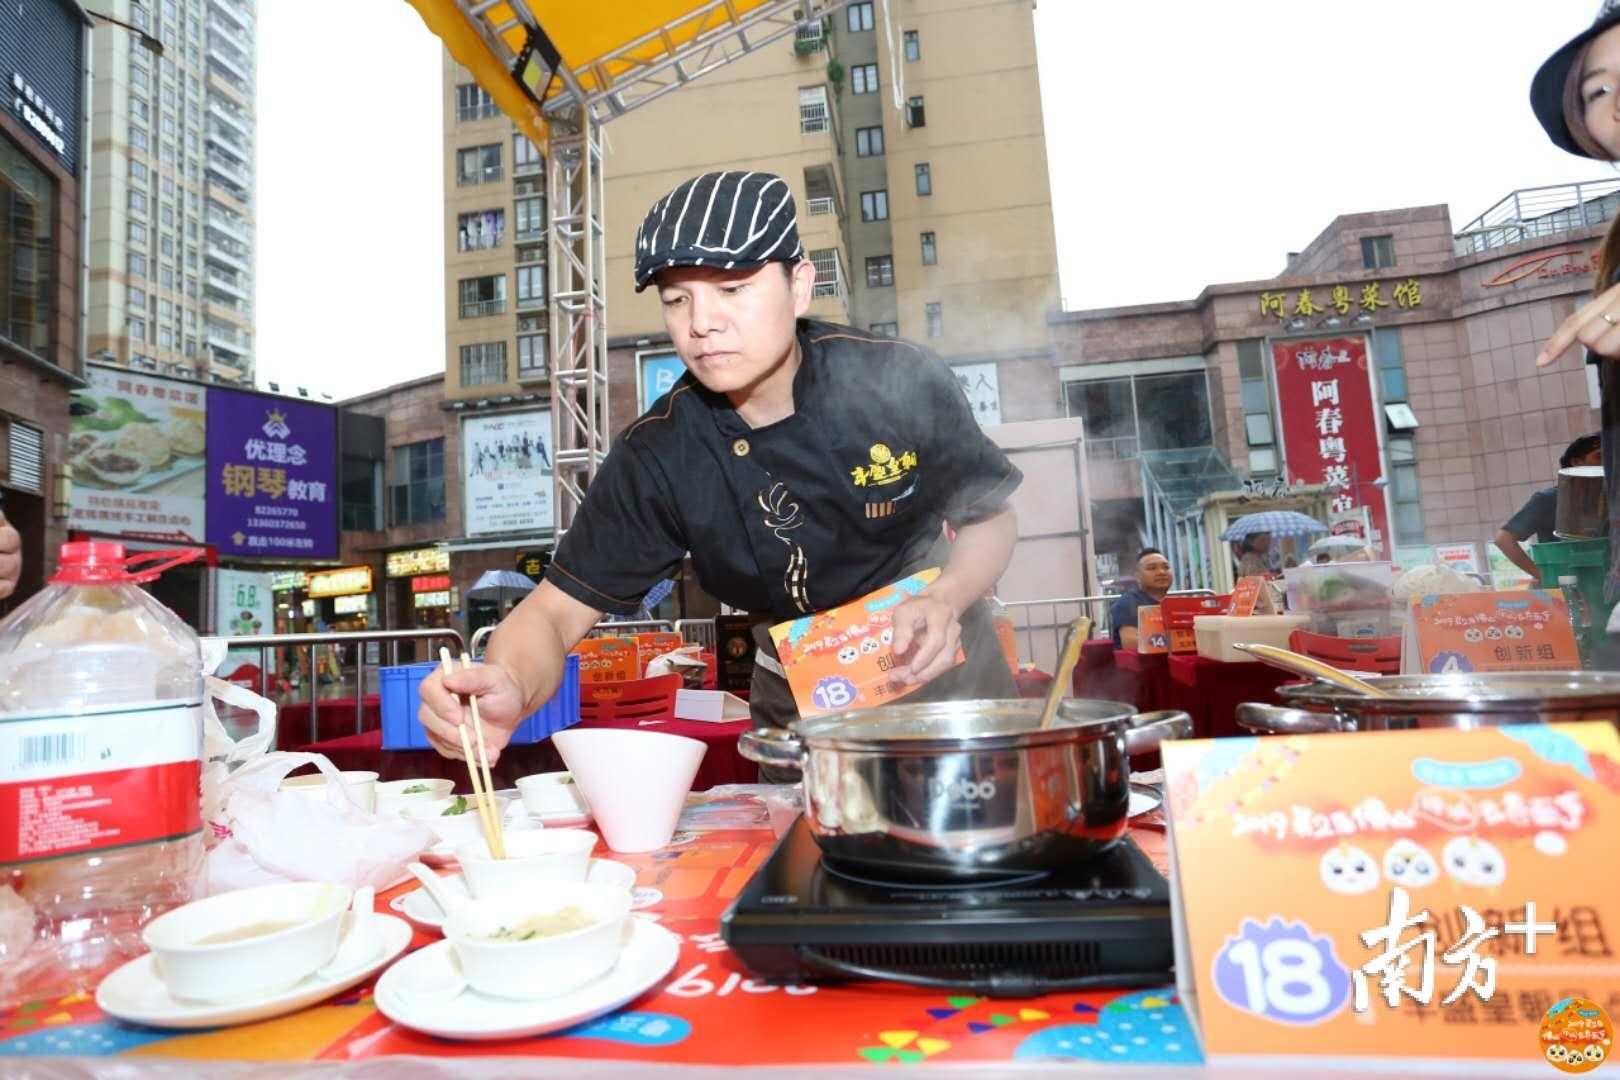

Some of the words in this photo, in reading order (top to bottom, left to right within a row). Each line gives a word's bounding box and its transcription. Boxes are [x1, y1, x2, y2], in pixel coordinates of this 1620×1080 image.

[1260, 279, 1422, 318] 阿春粤菜馆
[244, 437, 308, 466] 优理念
[222, 462, 328, 502] 钢琴教育
[1151, 636, 1165, 648] 14
[1494, 645, 1555, 662] 创新组
[816, 682, 850, 708] 18
[1228, 939, 1332, 1013] 18
